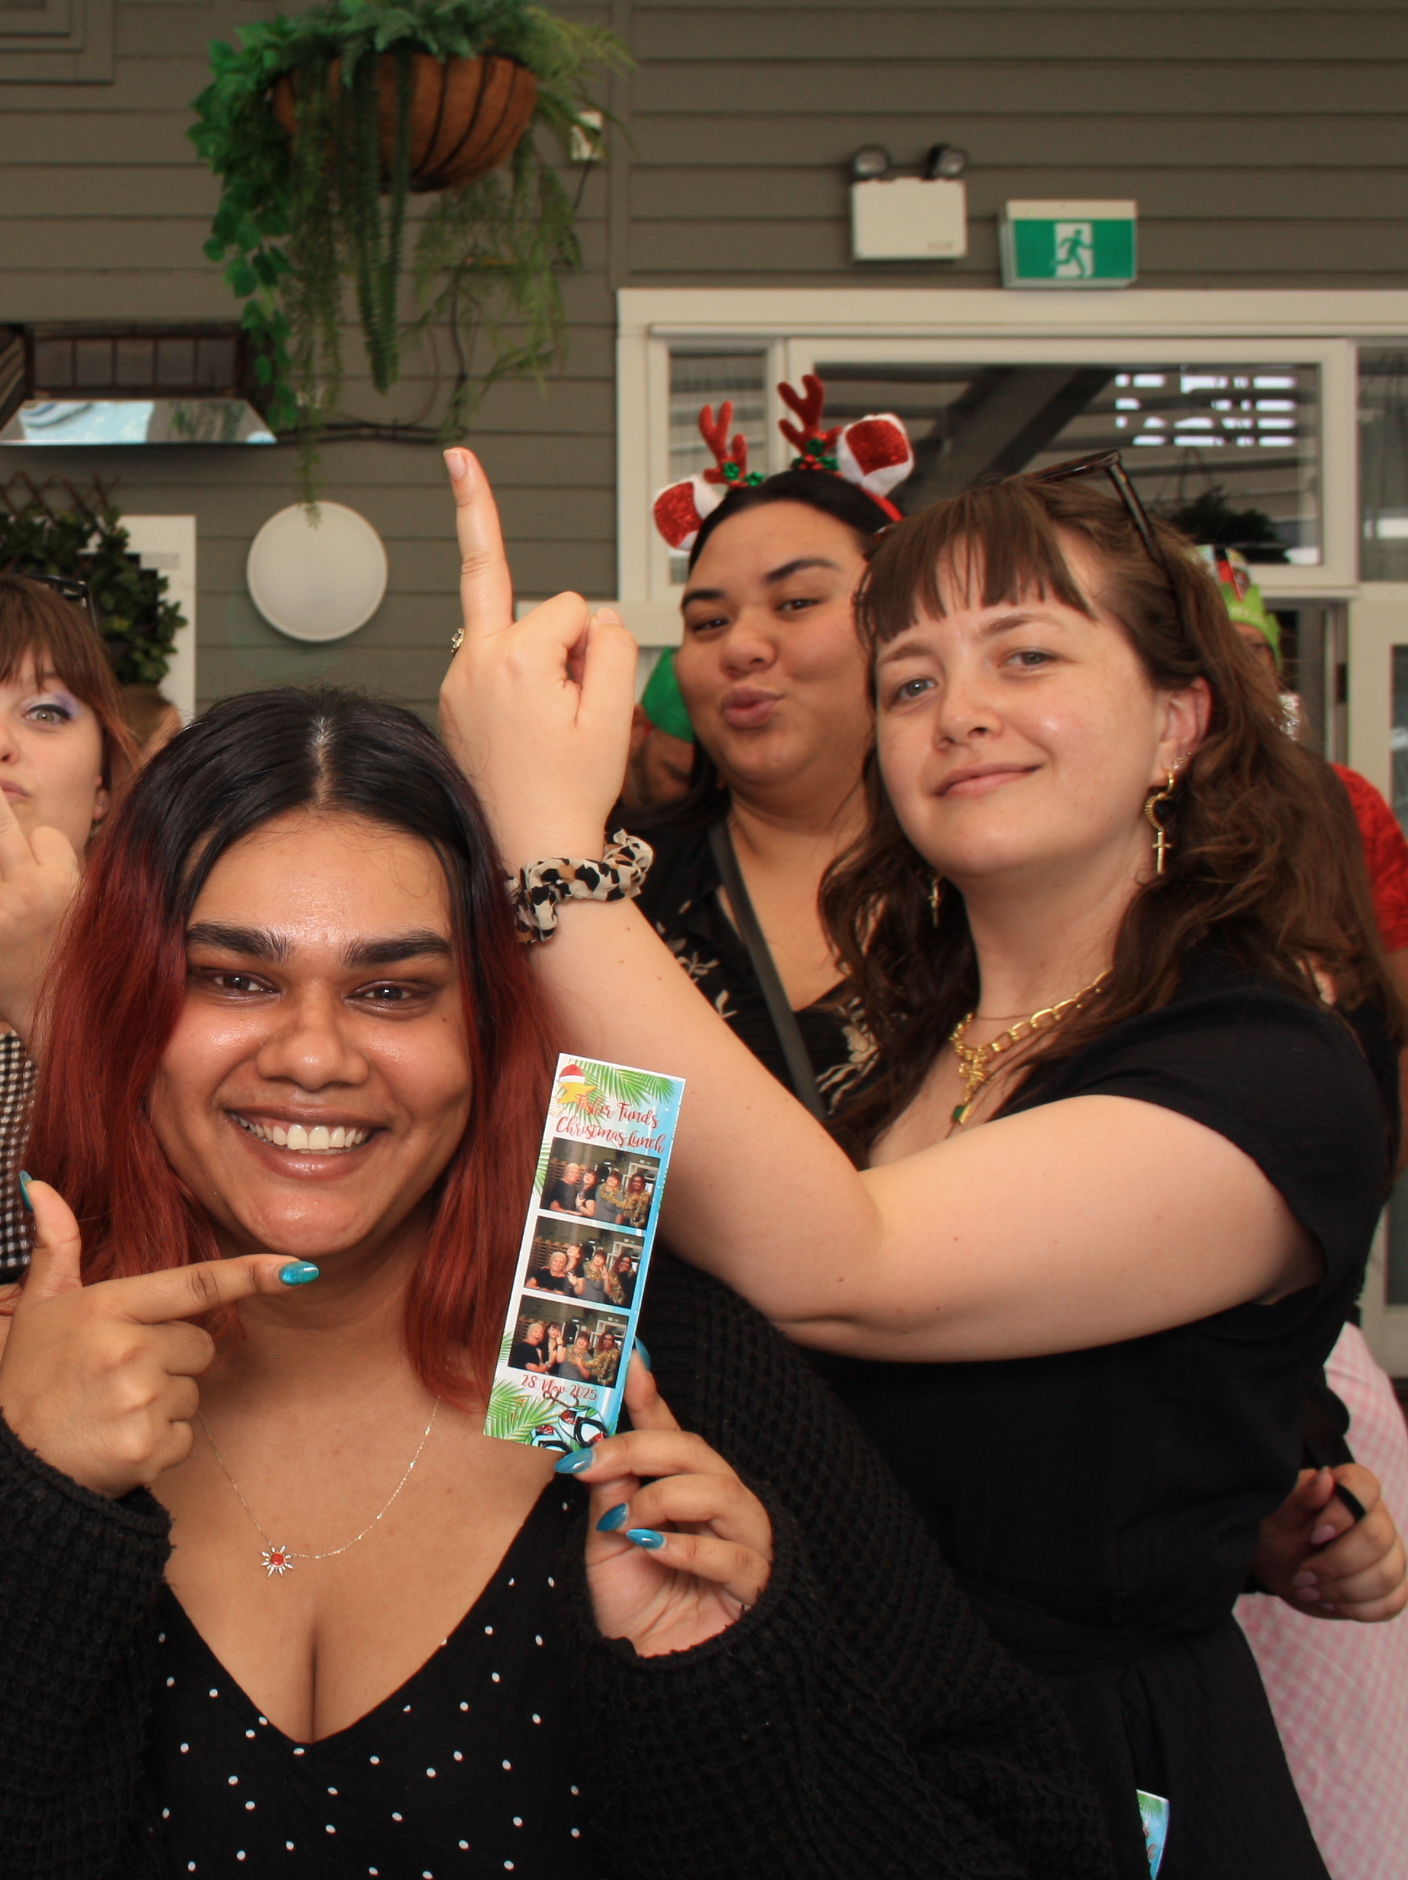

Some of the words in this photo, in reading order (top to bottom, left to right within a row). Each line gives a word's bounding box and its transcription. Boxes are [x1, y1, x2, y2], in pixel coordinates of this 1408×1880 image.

[617, 1102, 659, 1129] Funds
[556, 1116, 626, 1149] Christmas
[627, 1130, 666, 1154] Lunch
[521, 1374, 537, 1389] 28
[541, 1379, 567, 1395] Nov
[570, 1385, 597, 1401] 2025
